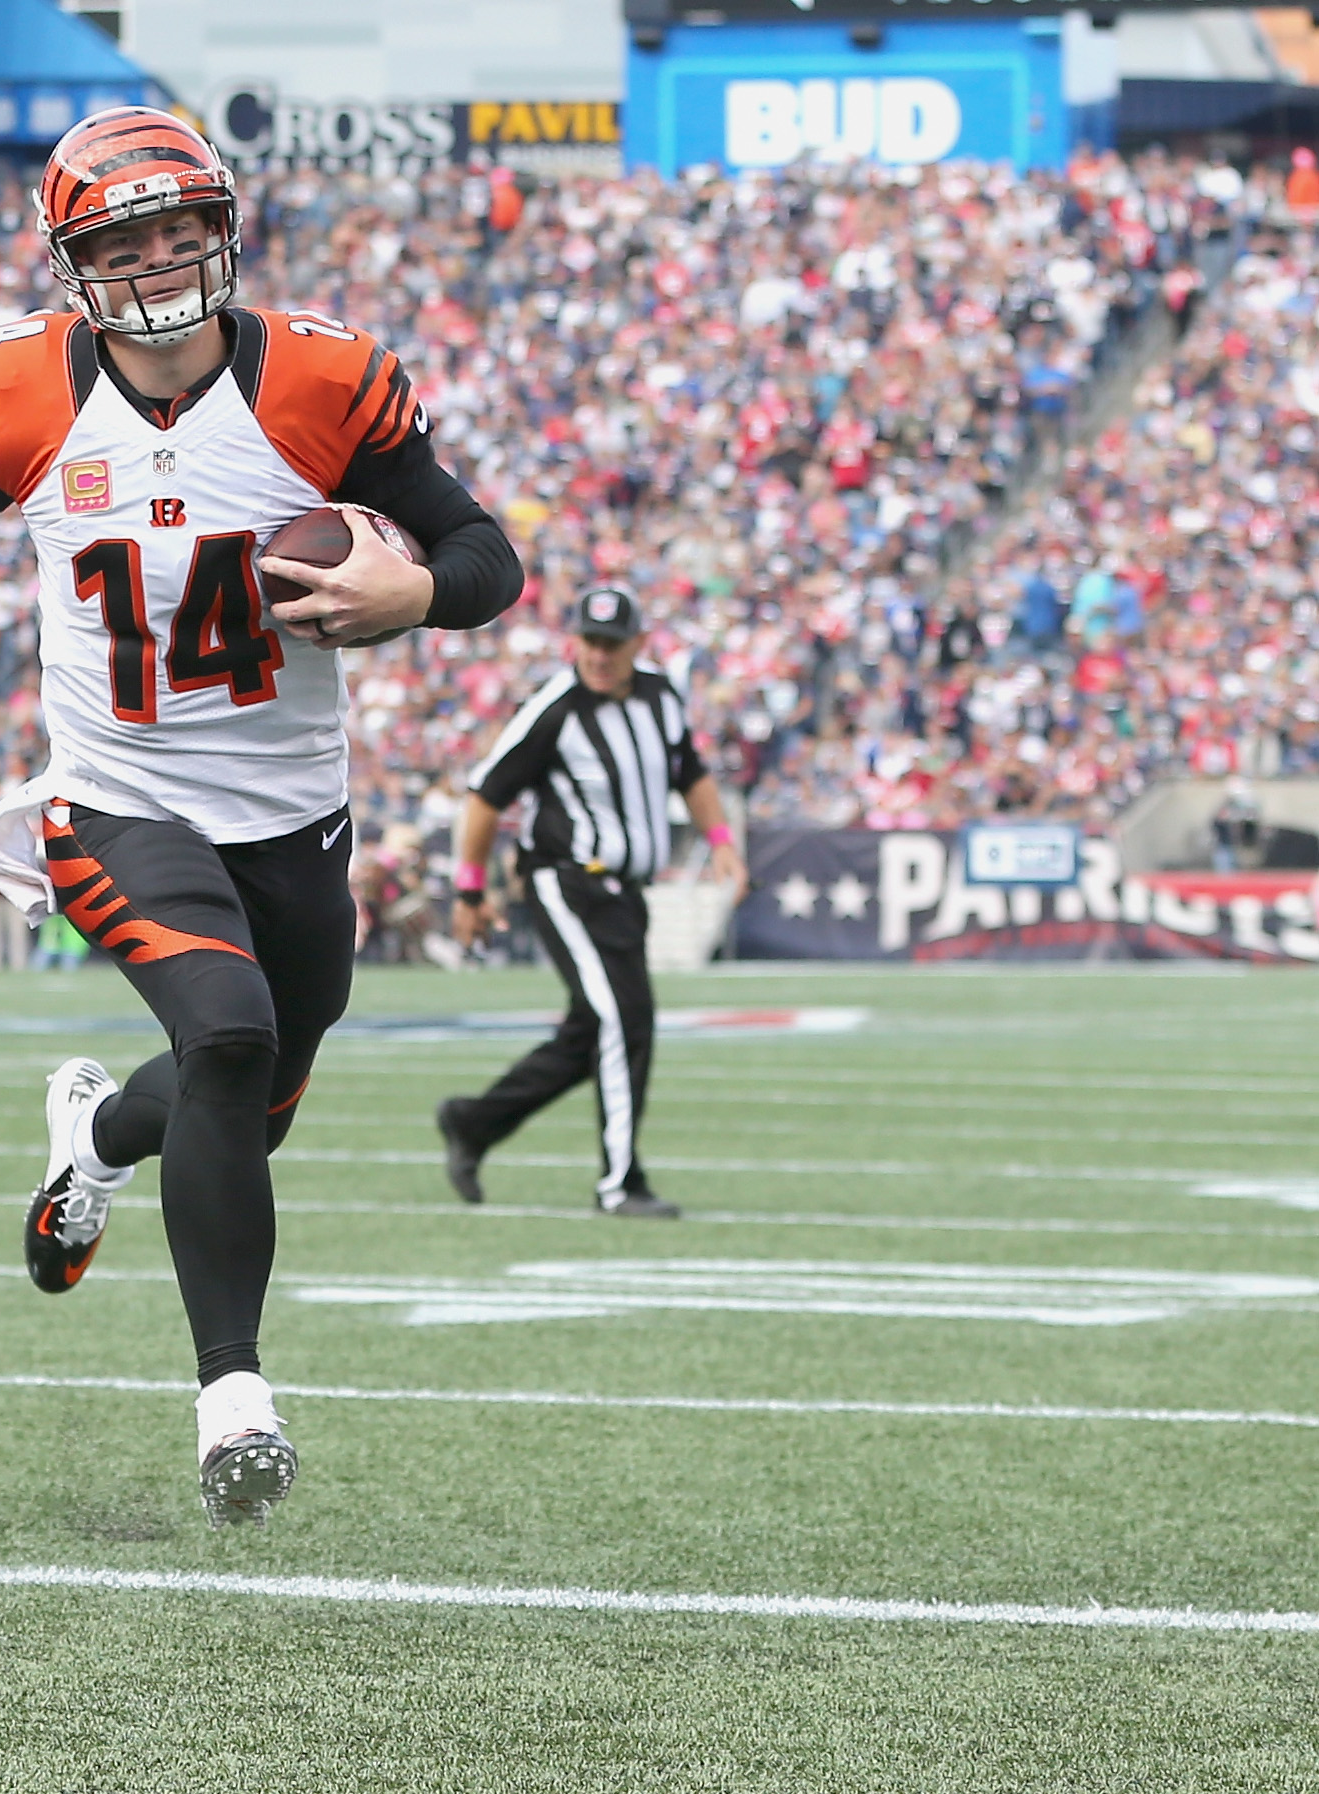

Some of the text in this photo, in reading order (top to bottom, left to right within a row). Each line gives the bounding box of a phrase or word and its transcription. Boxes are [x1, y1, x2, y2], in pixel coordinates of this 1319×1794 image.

[724, 76, 962, 166] BUD
[65, 463, 107, 500] C
[154, 461, 174, 473] NFL
[72, 529, 285, 724] 14
